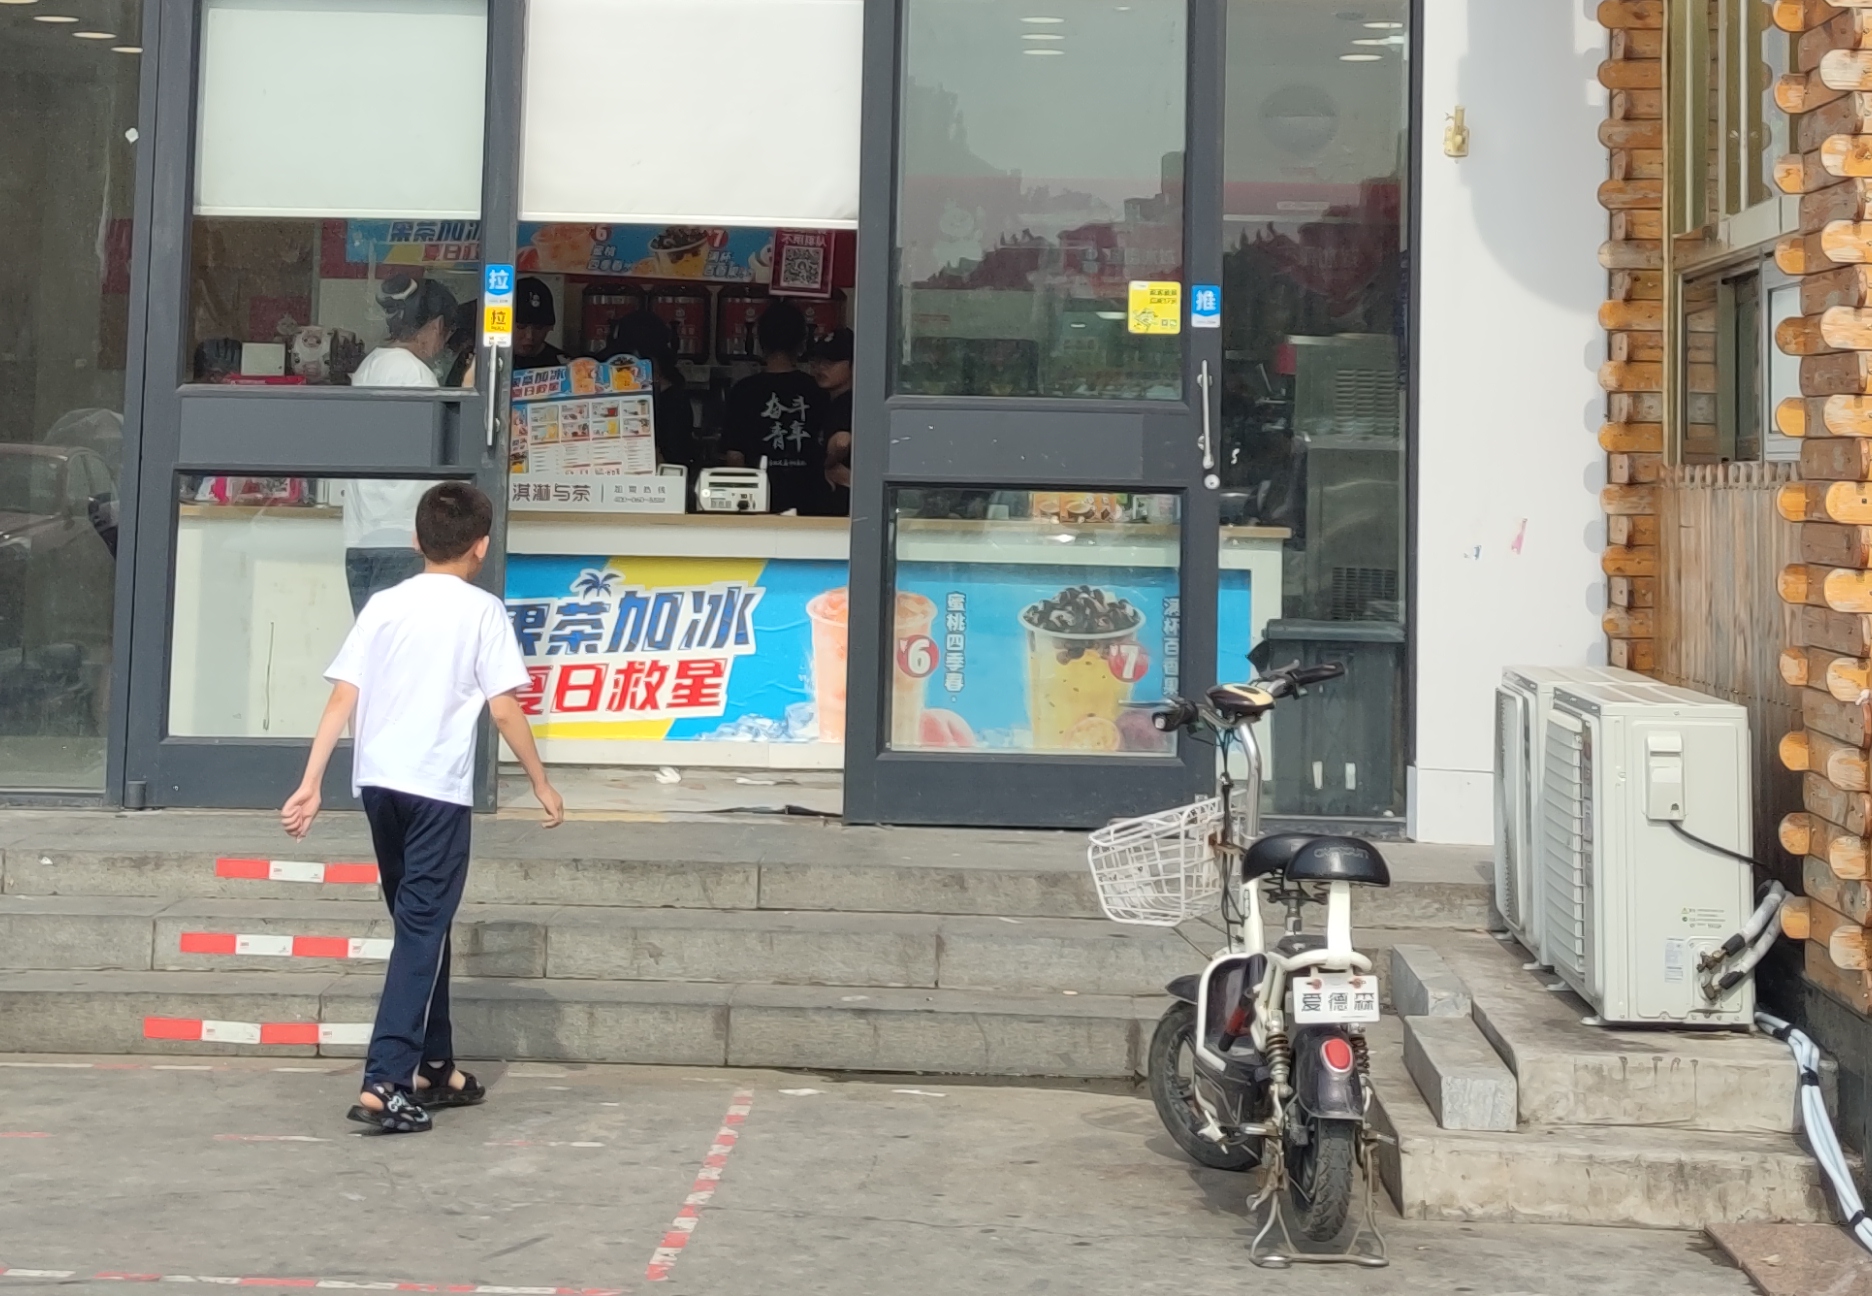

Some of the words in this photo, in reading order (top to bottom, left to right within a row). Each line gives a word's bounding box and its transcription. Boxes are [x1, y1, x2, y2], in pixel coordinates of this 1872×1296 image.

[489, 269, 509, 290] 拉
[1196, 290, 1216, 311] 推
[491, 309, 506, 325] 拉
[762, 420, 811, 452] 青年
[945, 591, 967, 693] 蜜桃四季春
